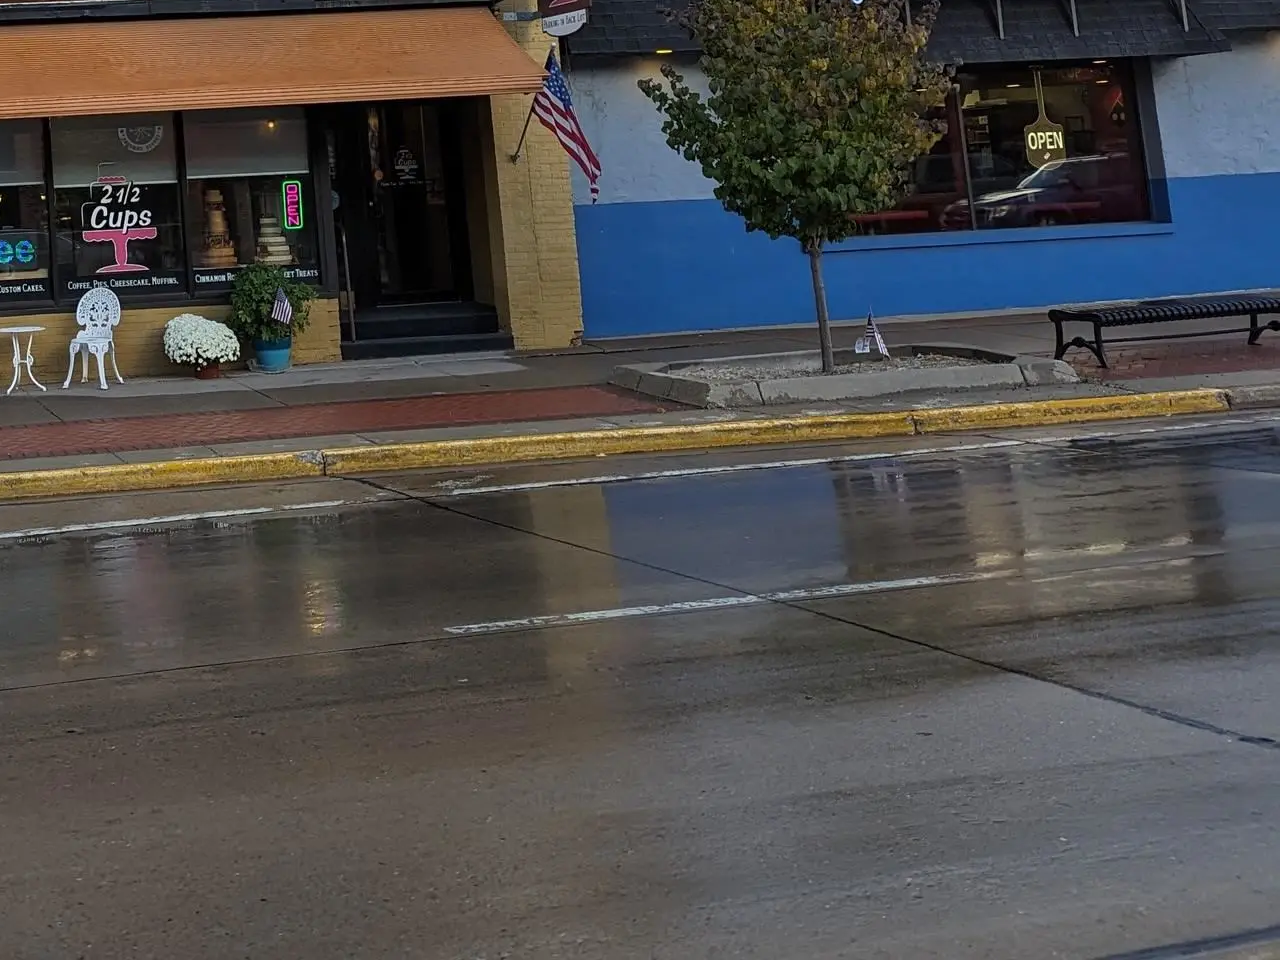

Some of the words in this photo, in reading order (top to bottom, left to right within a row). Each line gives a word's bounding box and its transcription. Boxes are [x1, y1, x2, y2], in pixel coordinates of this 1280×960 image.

[1028, 131, 1064, 150] OPEN
[286, 184, 300, 227] OPEN
[90, 205, 152, 235] Cups
[194, 273, 226, 283] CINNAMON
[295, 268, 319, 278] TREATS
